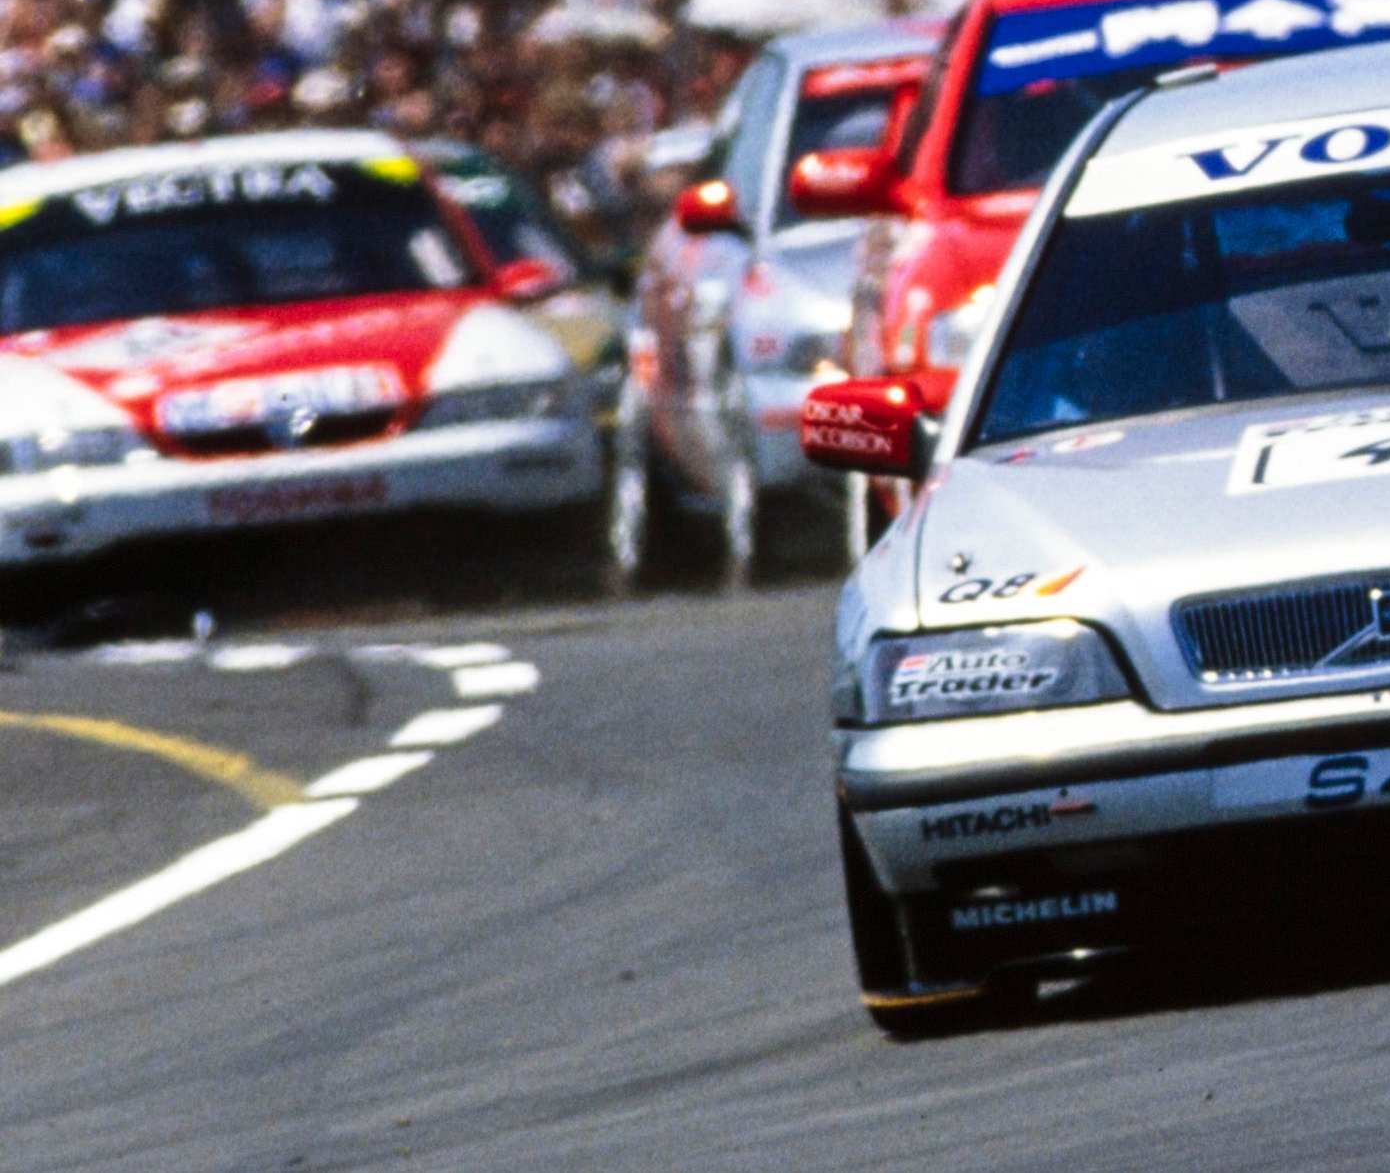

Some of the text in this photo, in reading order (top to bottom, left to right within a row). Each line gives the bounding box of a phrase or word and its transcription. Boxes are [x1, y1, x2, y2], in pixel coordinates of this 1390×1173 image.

[801, 398, 863, 423] OSCAR
[938, 571, 1037, 605] Q8
[925, 650, 1028, 675] Auto
[896, 671, 1054, 699] Trader
[921, 803, 1053, 843] HITACHI
[953, 890, 1121, 930] MICHELIN
